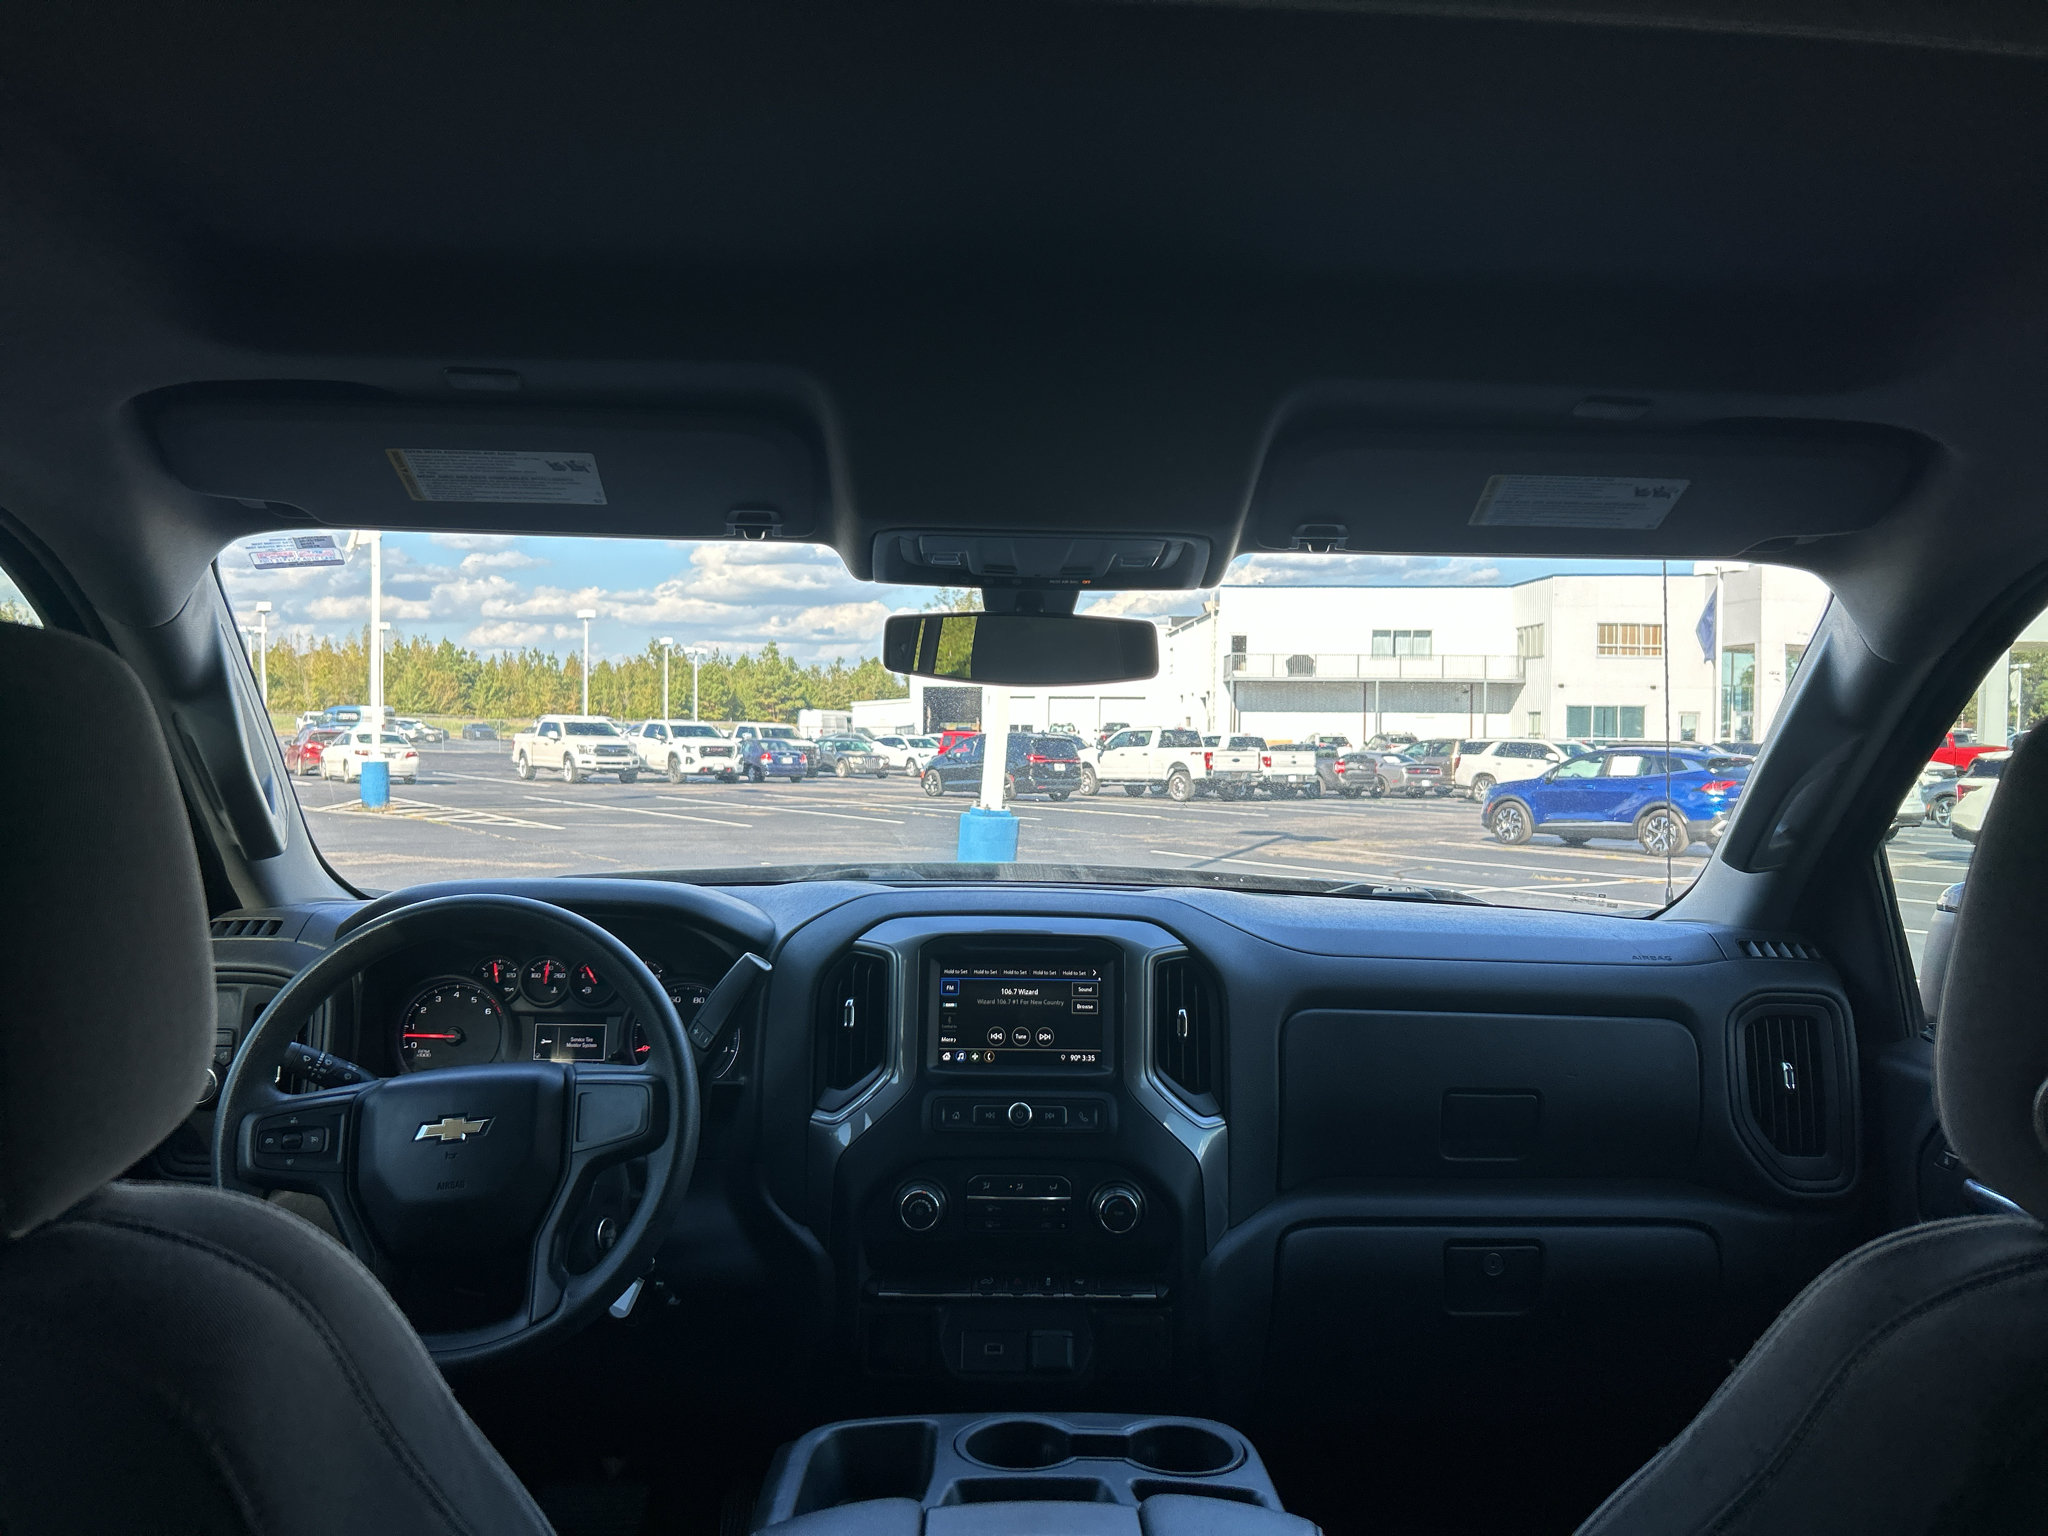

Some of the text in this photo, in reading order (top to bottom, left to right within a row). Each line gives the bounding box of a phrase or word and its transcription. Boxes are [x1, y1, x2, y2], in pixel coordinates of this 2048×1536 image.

[1018, 988, 1039, 996] Wizard
[693, 996, 705, 1004] 80
[420, 1006, 427, 1014] 2
[411, 1041, 418, 1049] 0
[1082, 1054, 1096, 1062] 3:35
